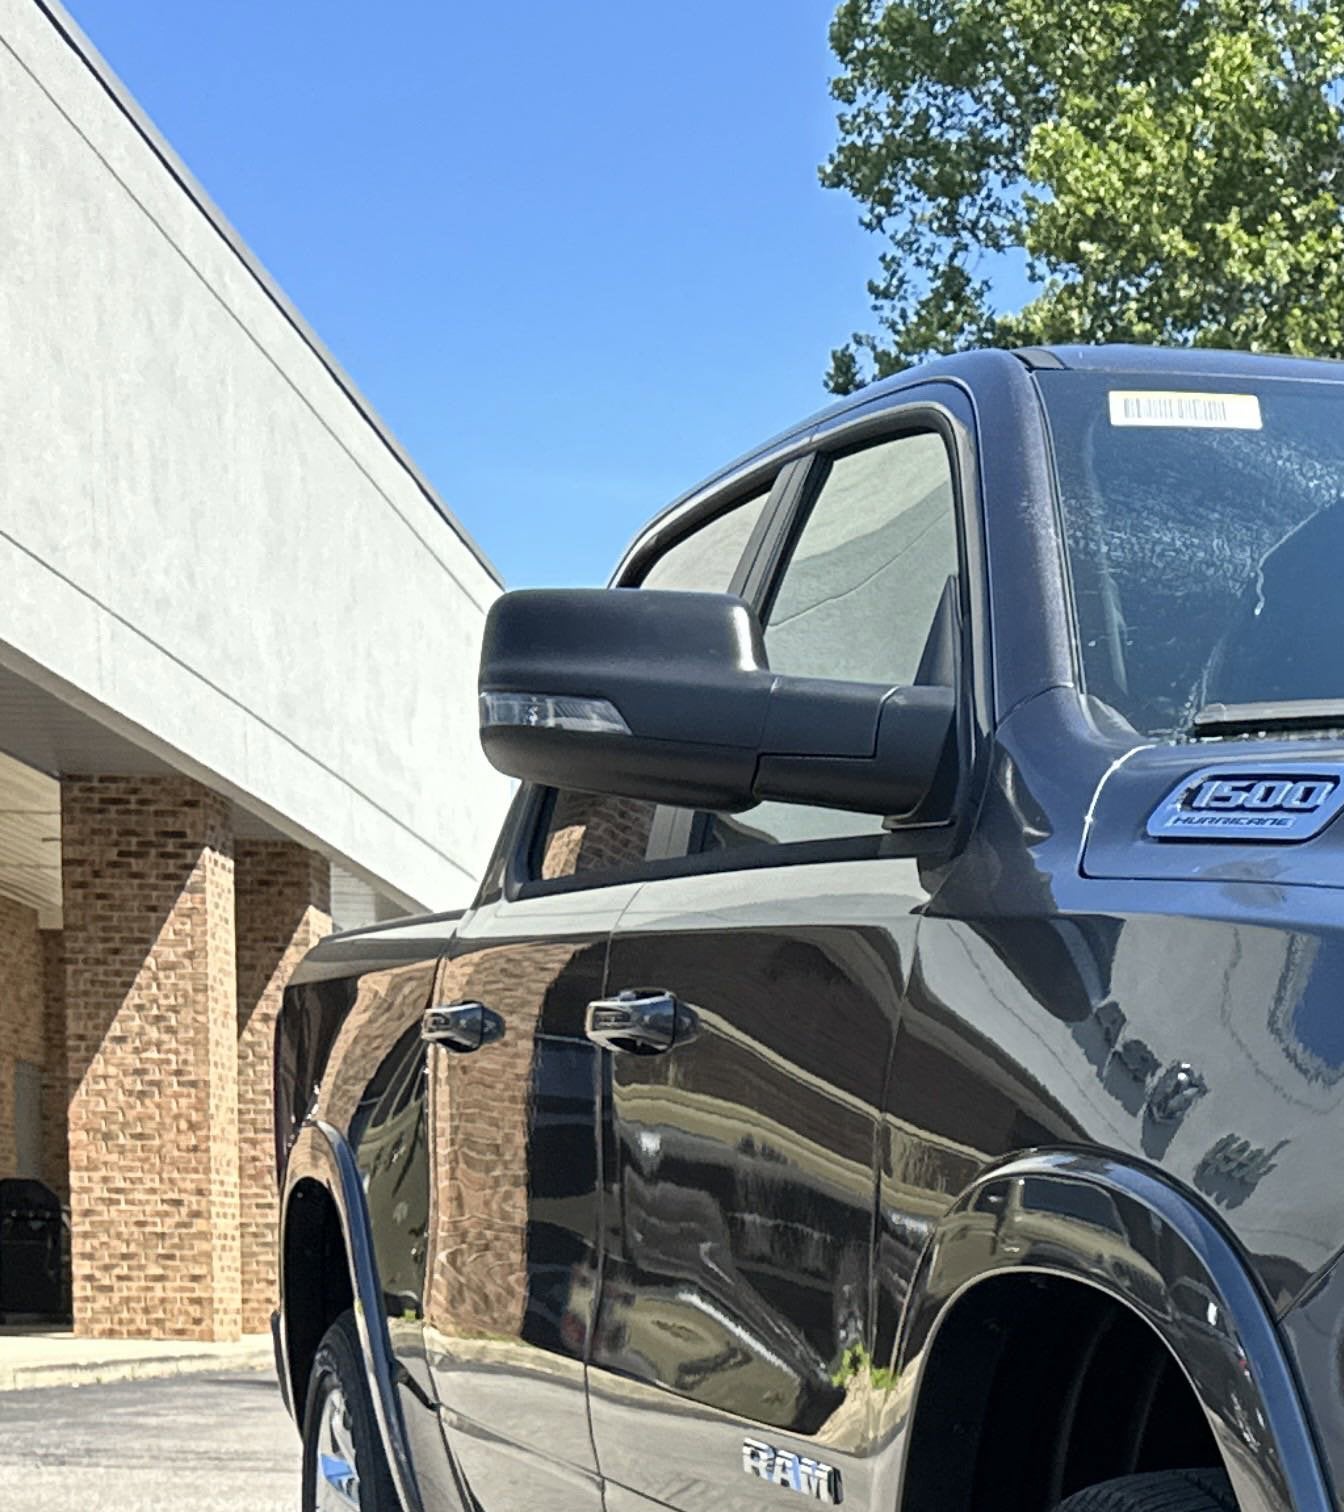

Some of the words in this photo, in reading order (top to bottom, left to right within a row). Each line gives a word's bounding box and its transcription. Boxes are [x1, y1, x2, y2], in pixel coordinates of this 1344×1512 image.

[1192, 779, 1336, 809] 1500
[1173, 816, 1291, 827] HURRICANE
[742, 1437, 843, 1505] RAM
